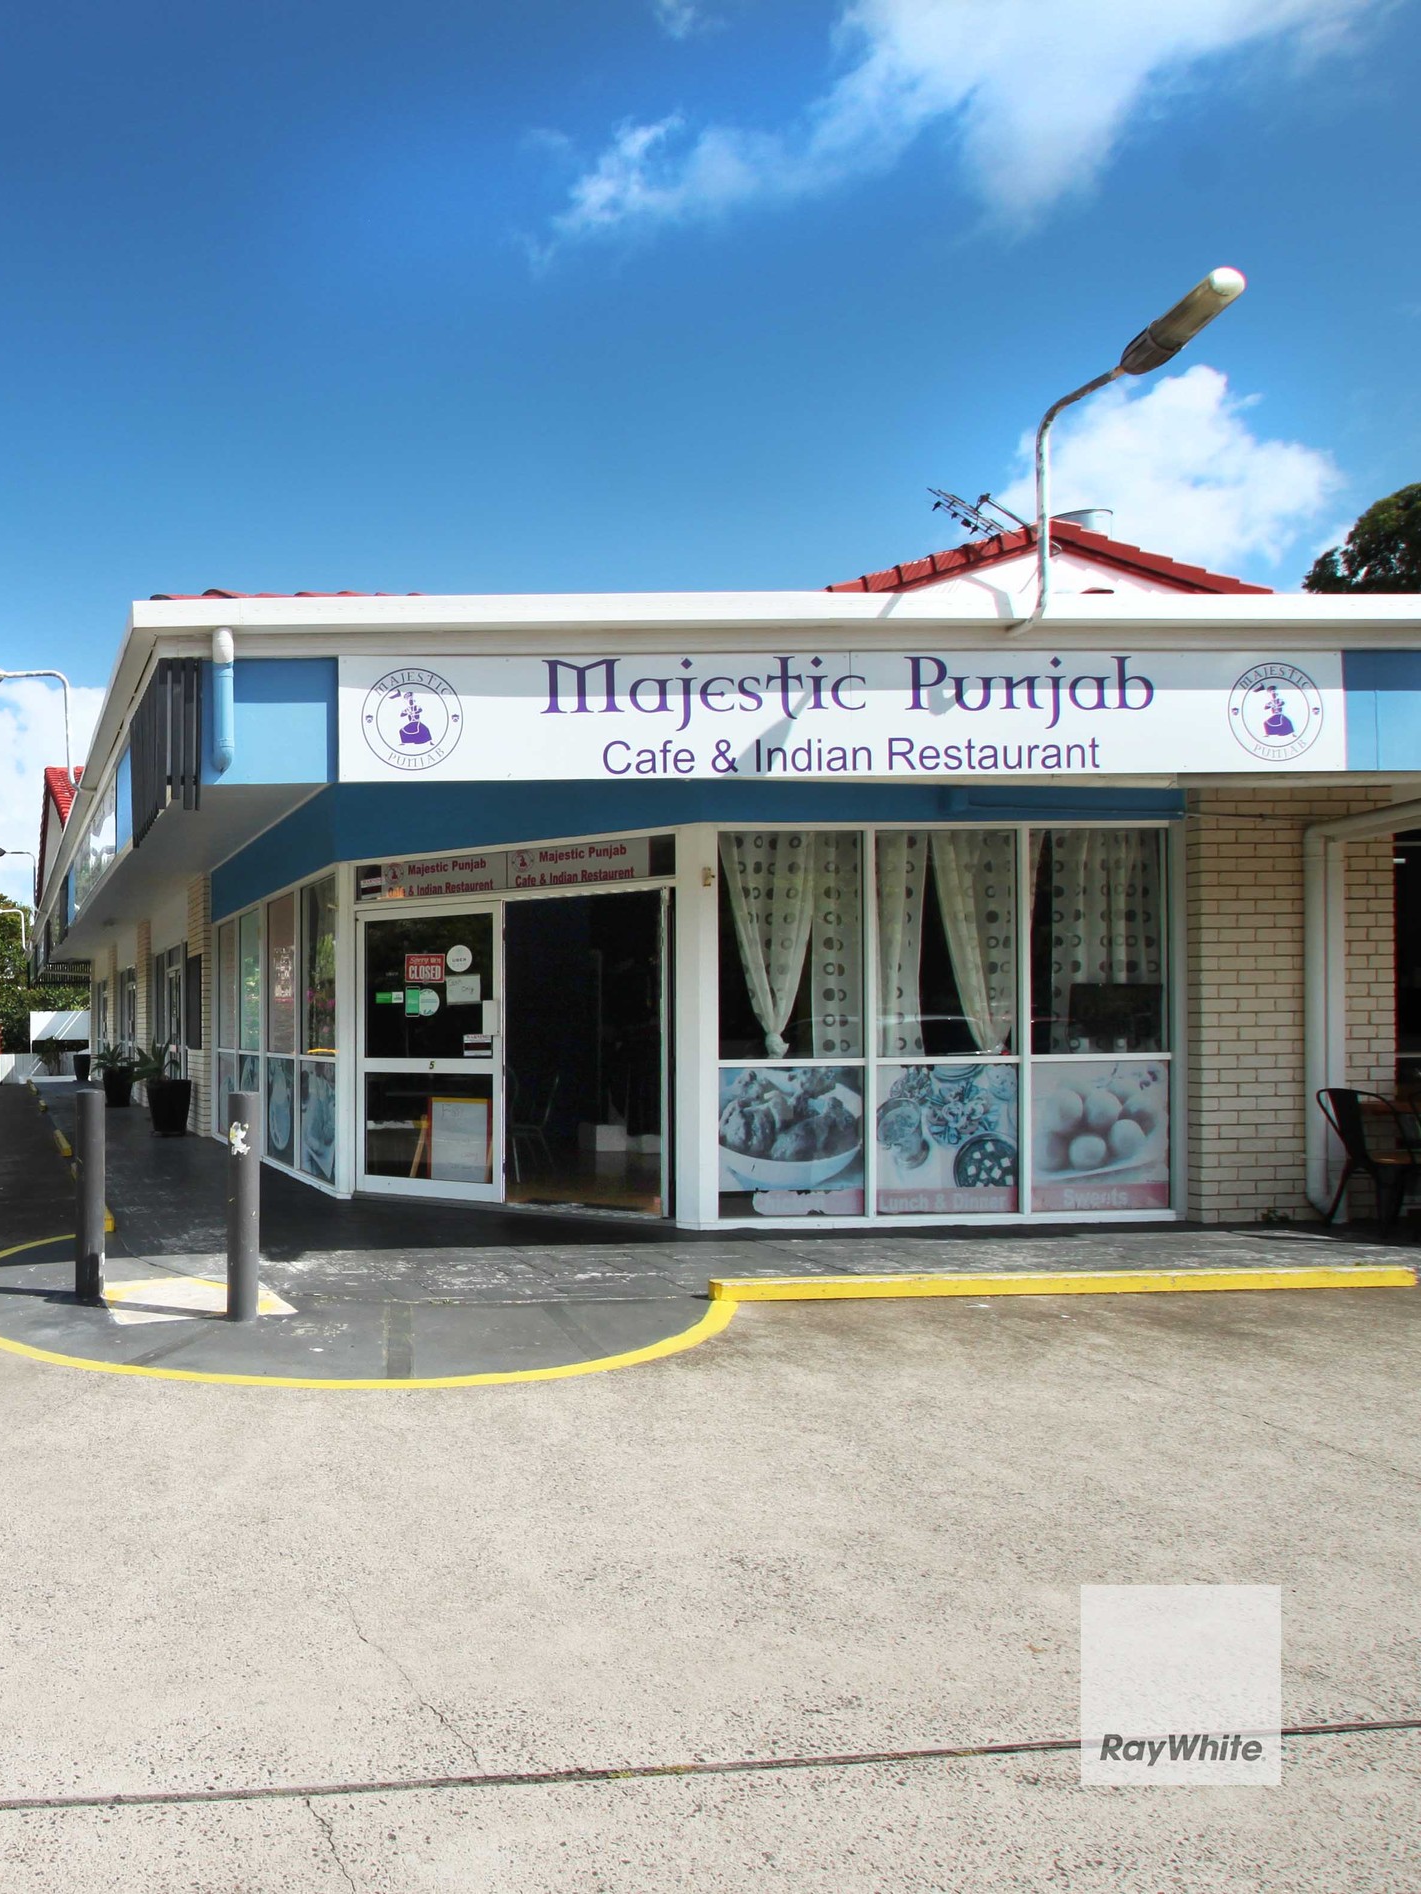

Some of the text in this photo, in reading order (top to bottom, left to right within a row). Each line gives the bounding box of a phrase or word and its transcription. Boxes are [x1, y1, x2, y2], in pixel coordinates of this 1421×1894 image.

[374, 671, 452, 697] MAJESTIC
[1239, 665, 1312, 691] MAJESTIC
[540, 655, 1155, 732] Majestic Punjab
[387, 747, 445, 768] PUNJAB
[602, 737, 1100, 775] Cafe & Indian Restaurant
[539, 848, 585, 864] Majestic
[588, 844, 627, 859] Punjab
[408, 862, 449, 877] Majestic
[452, 858, 487, 872] Punjab
[516, 866, 634, 888] Cafe & Indian Restaurent
[408, 885, 415, 896] &
[417, 883, 442, 896] Indian
[408, 965, 441, 980] CLOSED
[428, 1061, 435, 1070] 5
[879, 1193, 1005, 1211] Lunch & Dinner
